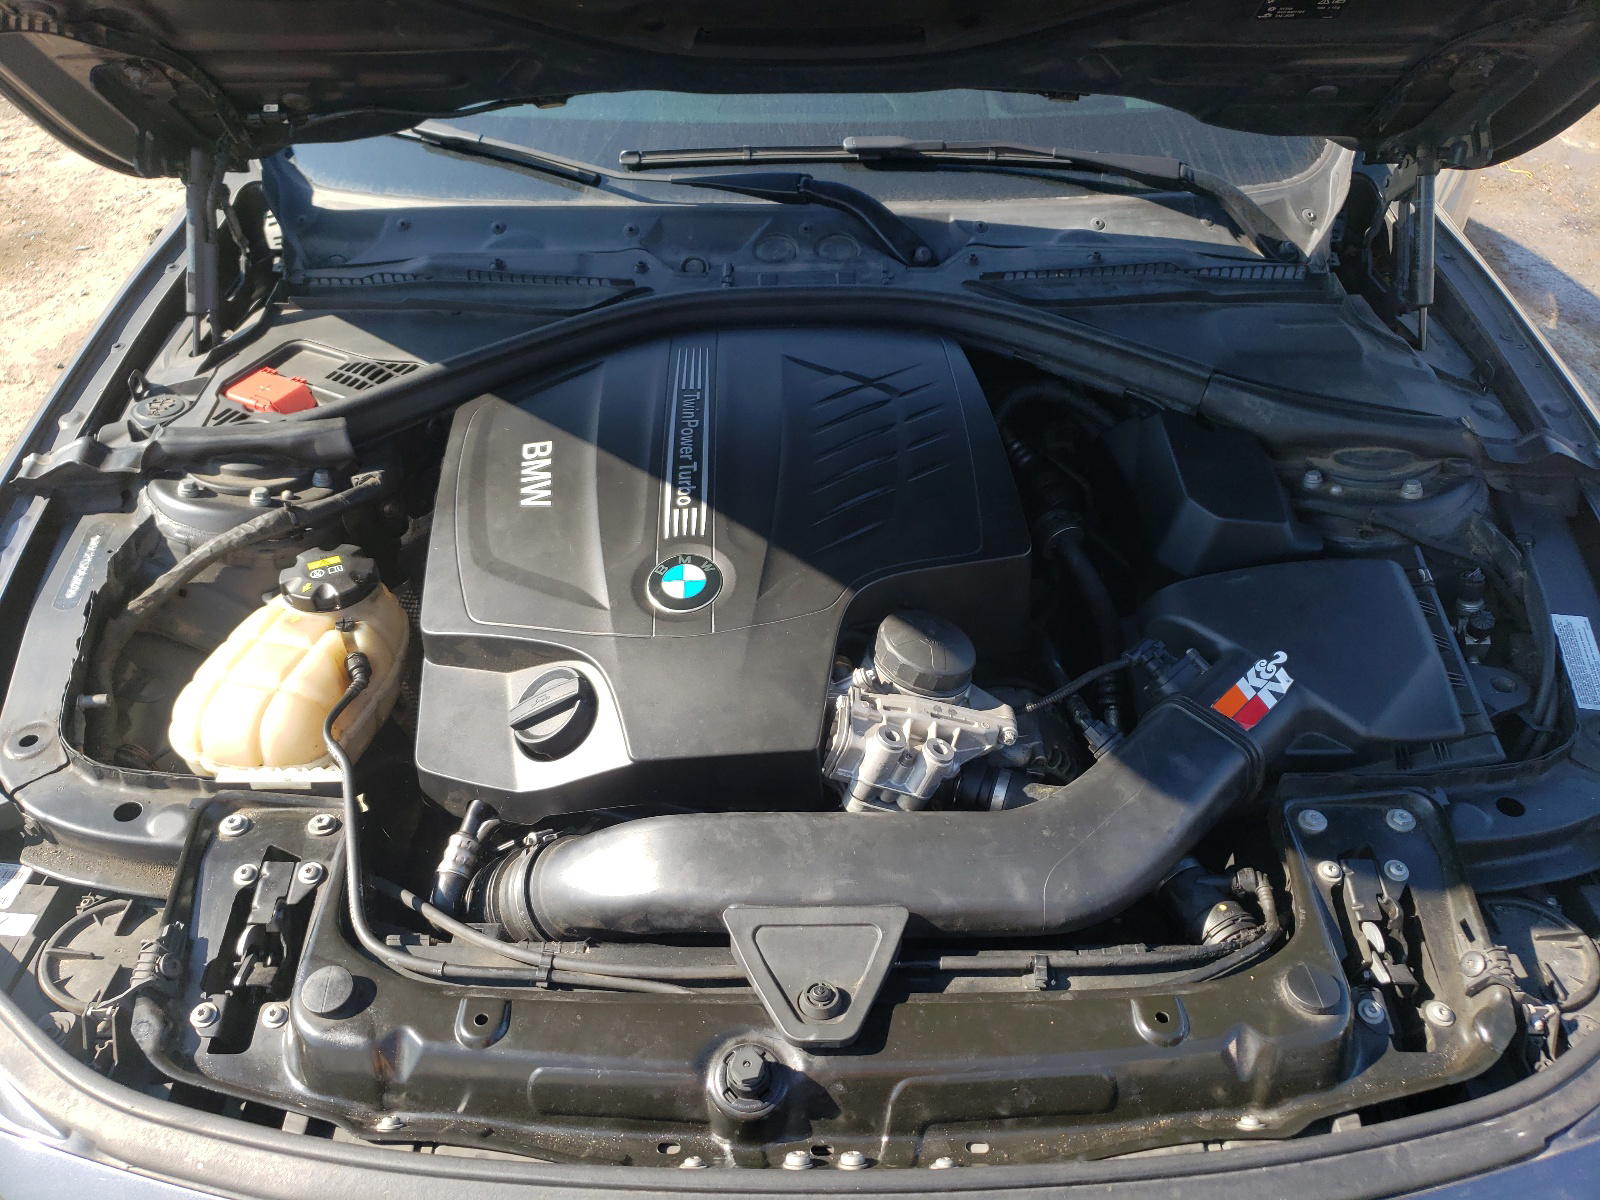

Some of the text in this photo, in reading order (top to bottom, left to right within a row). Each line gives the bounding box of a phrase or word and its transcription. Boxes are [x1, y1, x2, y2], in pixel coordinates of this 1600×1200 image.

[520, 441, 552, 507] BMW
[676, 391, 701, 506] TwinPower Turbo
[654, 556, 716, 575] BMW
[1235, 650, 1295, 710] K&N
